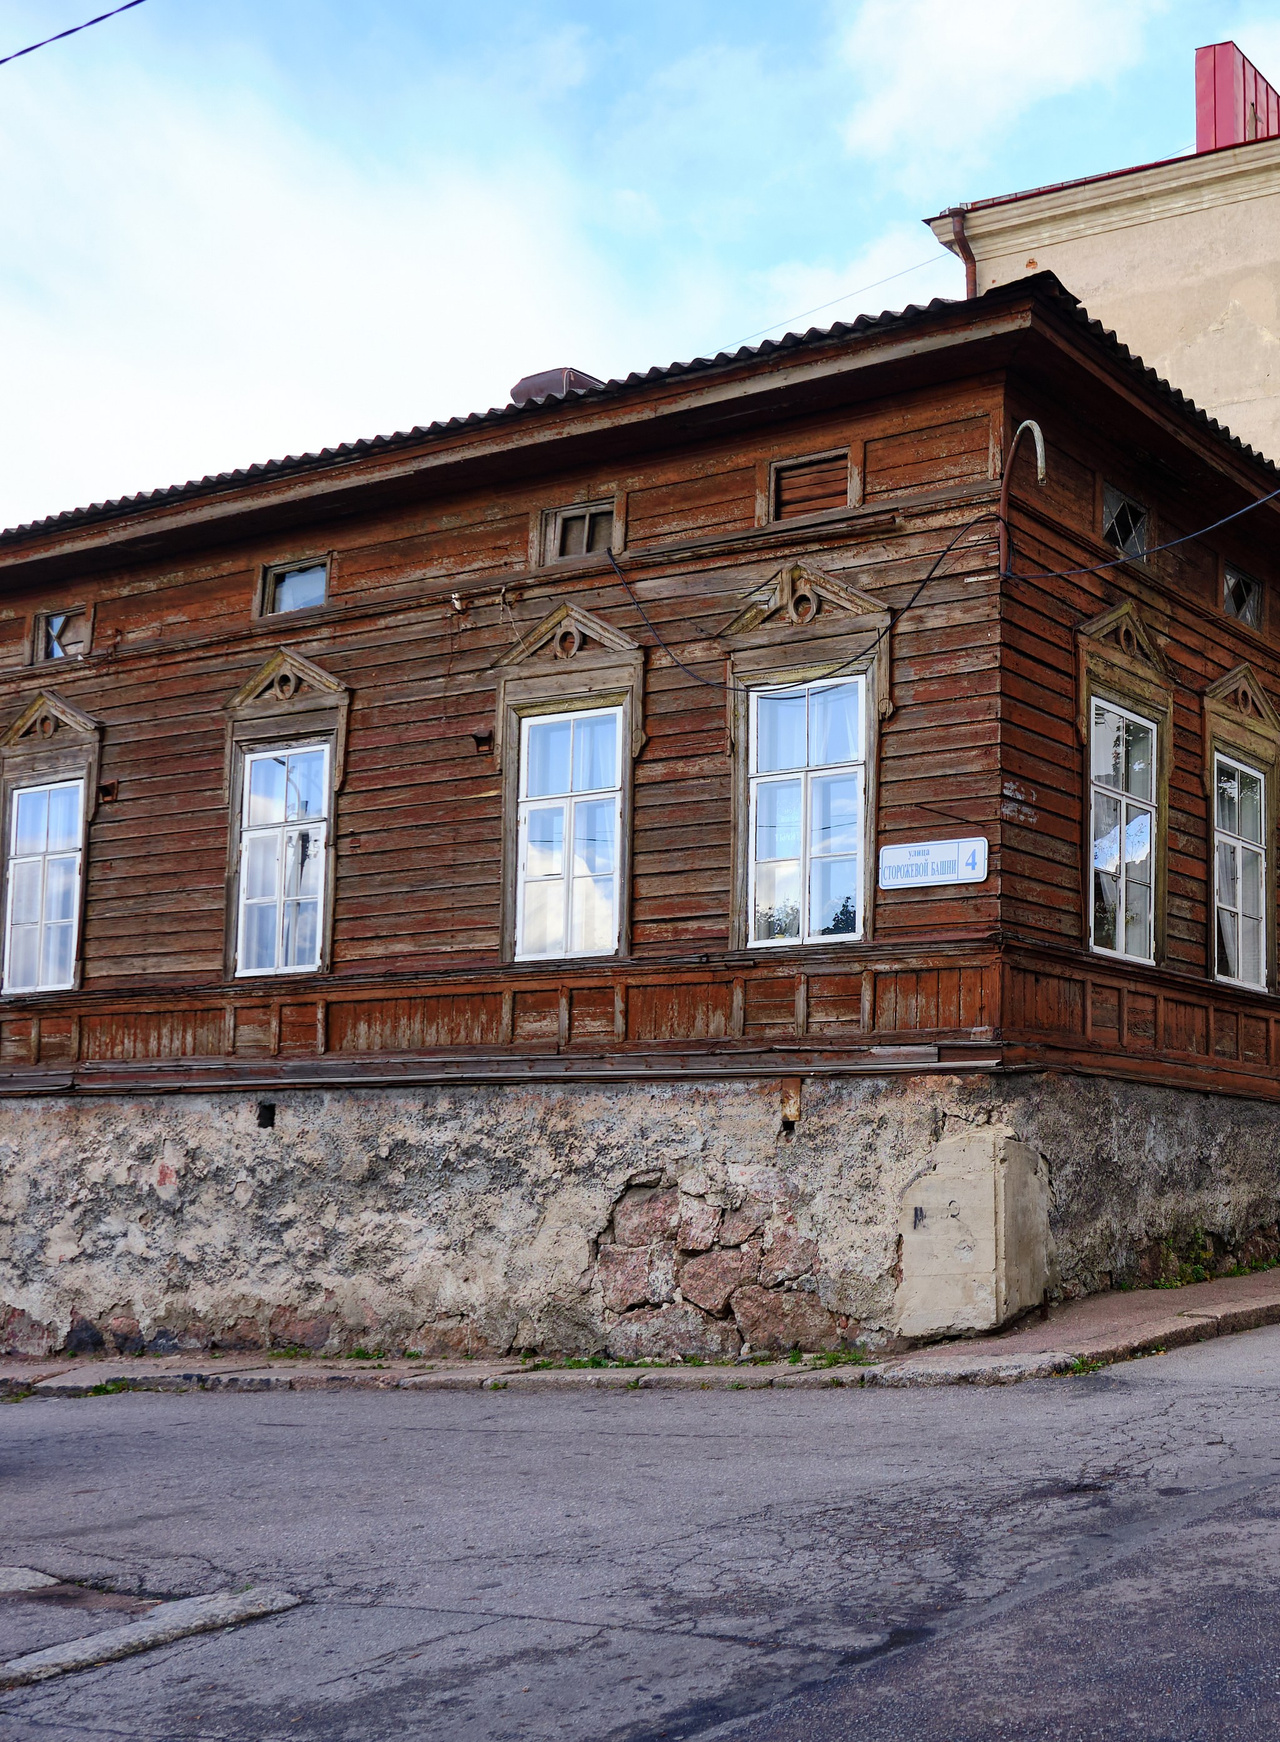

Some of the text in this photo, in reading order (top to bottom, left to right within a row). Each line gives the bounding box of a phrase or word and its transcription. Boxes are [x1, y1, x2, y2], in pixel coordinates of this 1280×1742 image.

[908, 848, 930, 860] улица
[965, 848, 978, 871] 4
[883, 859, 957, 881] СТОРОЖЕВОЙ БАШНИ
